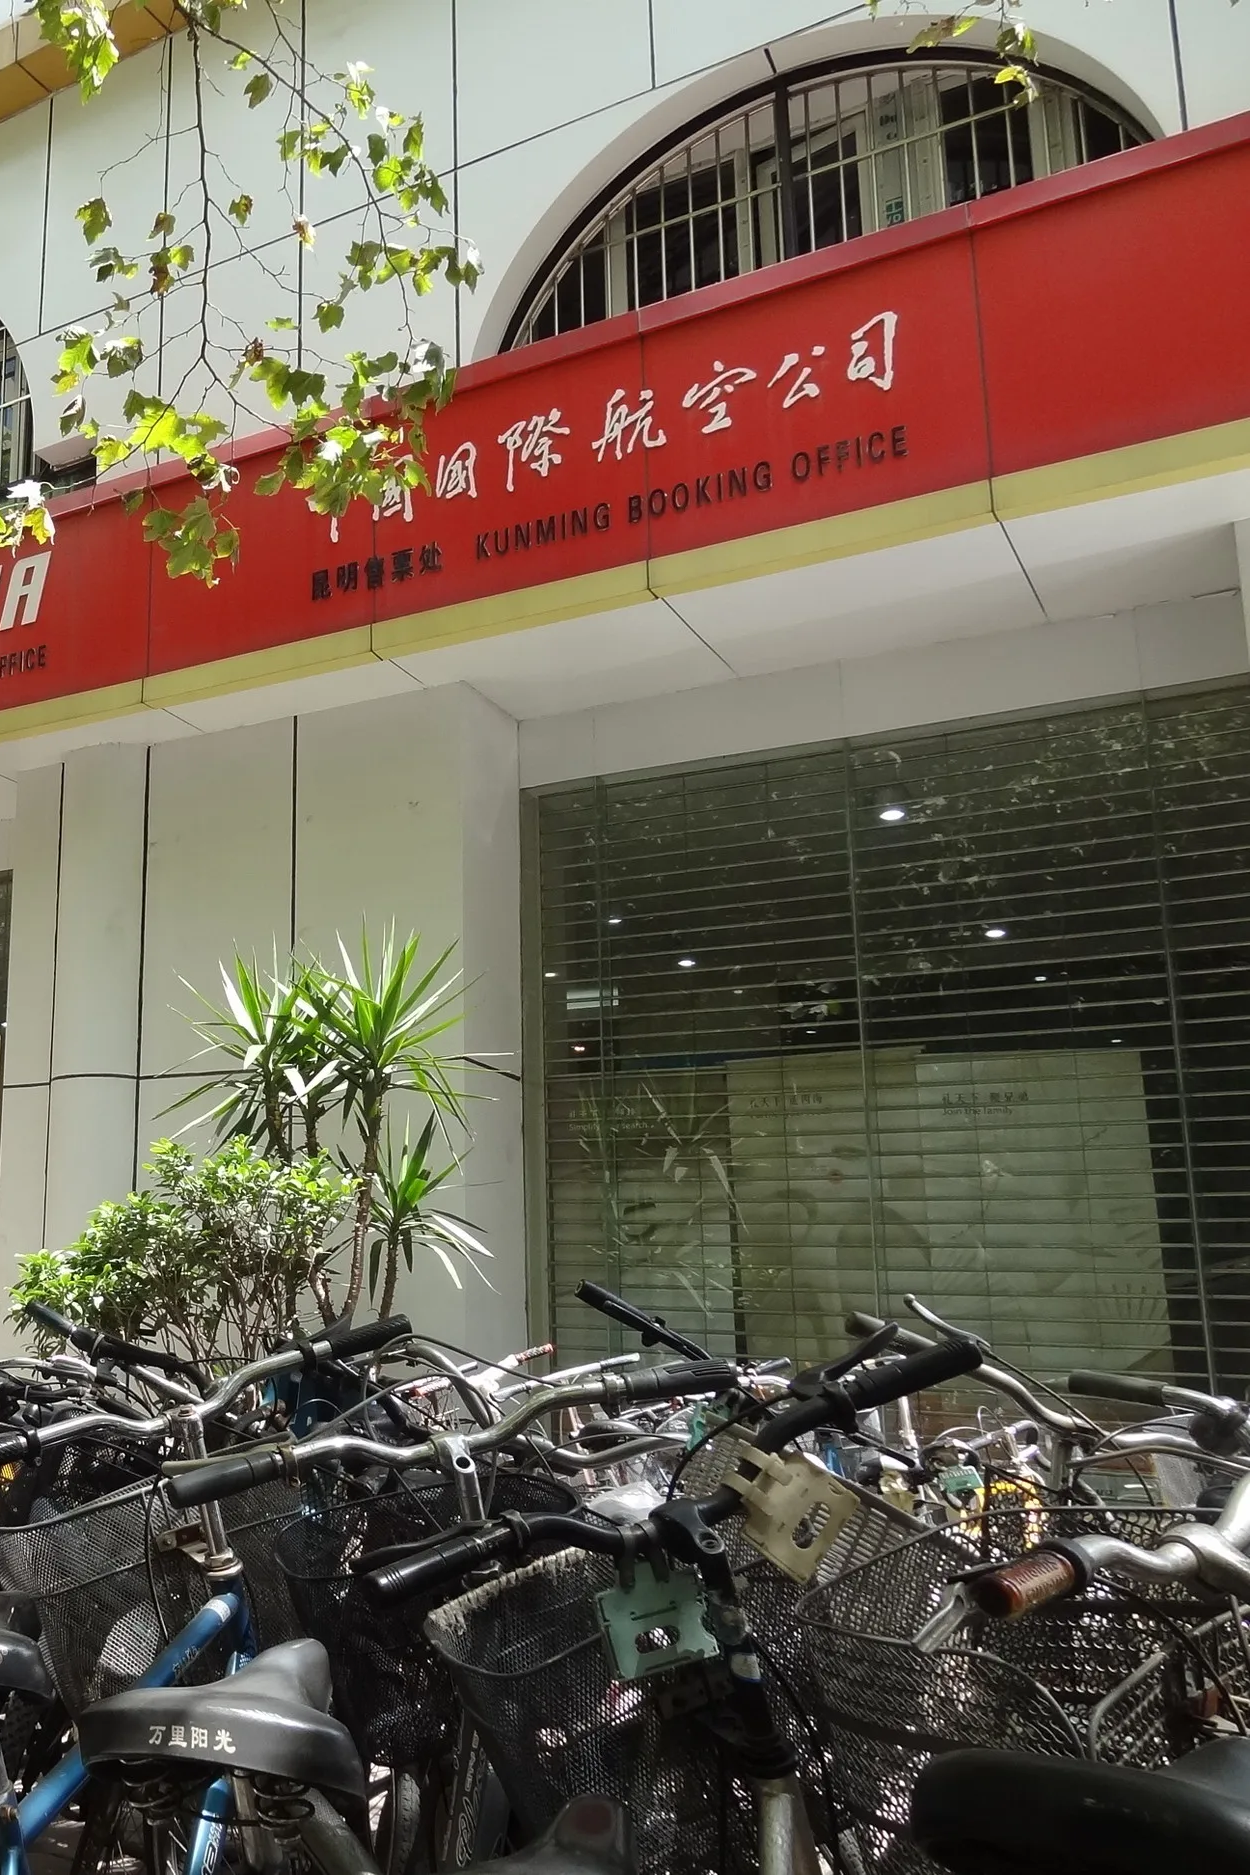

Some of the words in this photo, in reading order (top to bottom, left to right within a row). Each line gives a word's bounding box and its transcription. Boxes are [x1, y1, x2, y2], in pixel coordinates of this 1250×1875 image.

[476, 501, 612, 560] KUNMING
[628, 460, 773, 524] BOOKING
[790, 424, 909, 480] OFFICE
[148, 1724, 237, 1755] 万里阳光
